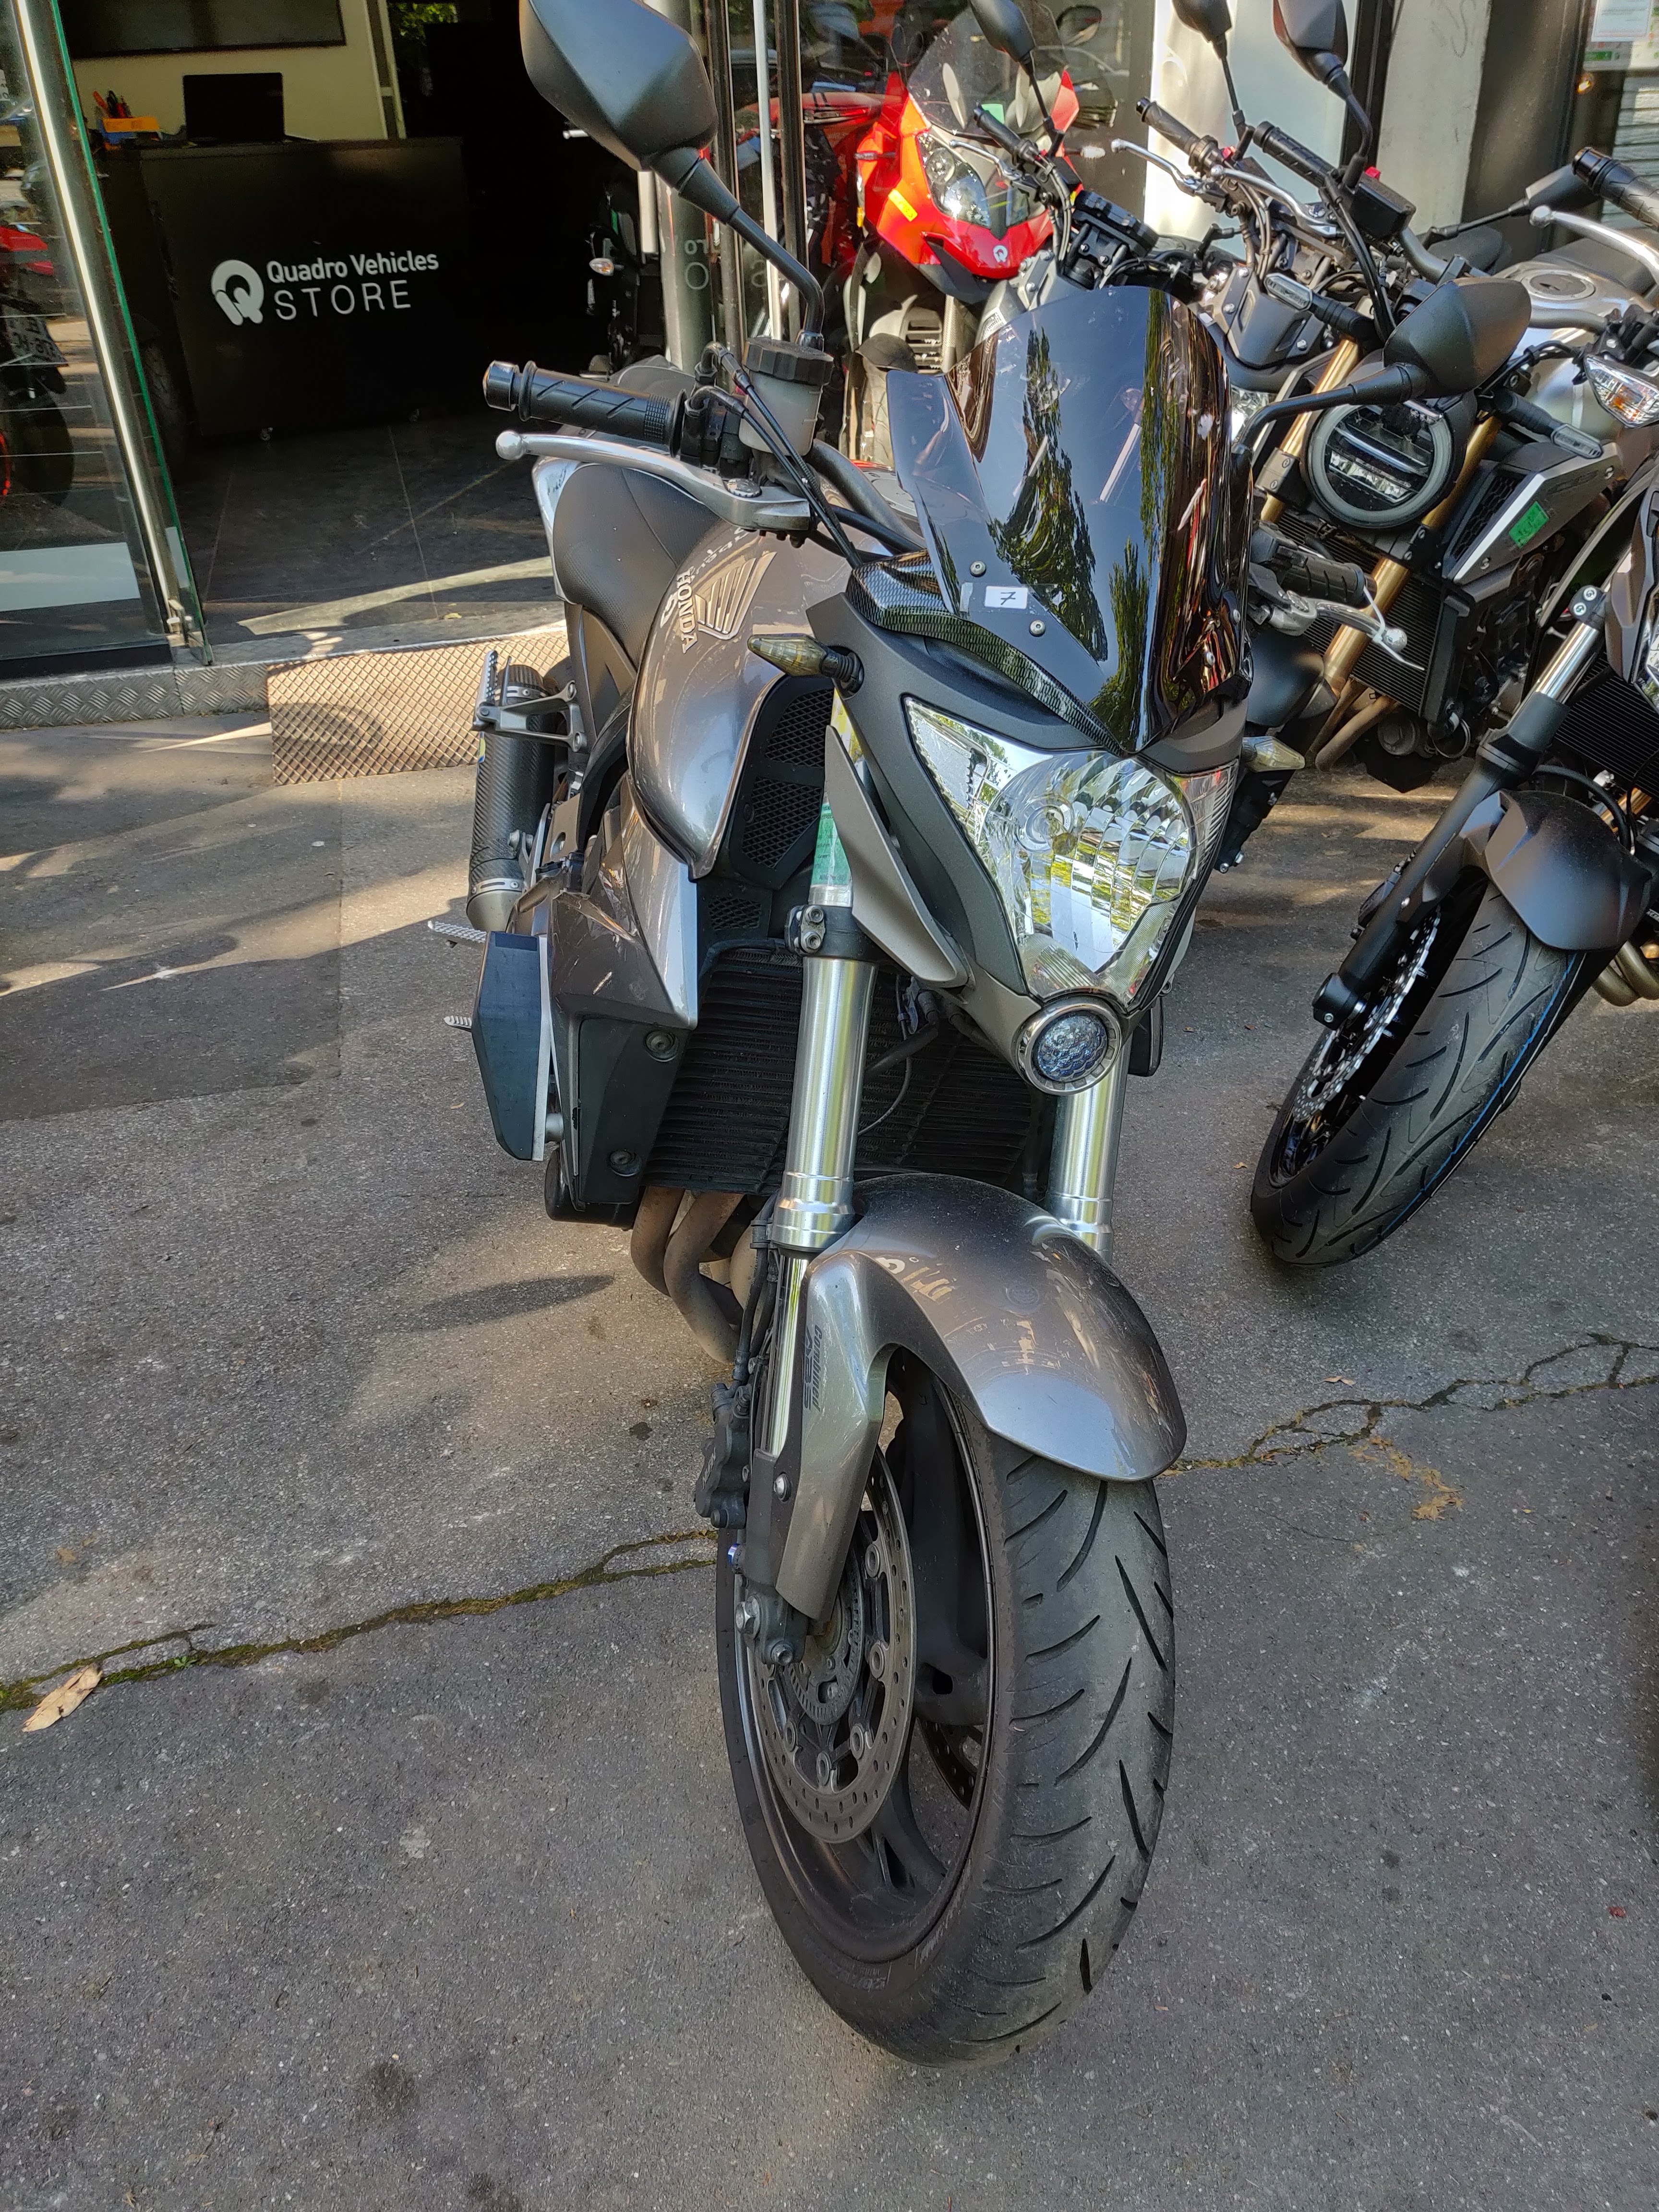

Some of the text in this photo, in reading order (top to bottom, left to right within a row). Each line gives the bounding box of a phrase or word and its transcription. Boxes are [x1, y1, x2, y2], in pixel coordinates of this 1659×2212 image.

[266, 250, 439, 283] Quadro Vehicles
[274, 280, 411, 320] STORE
[676, 570, 698, 654] HONDA
[1000, 591, 1016, 606] 7
[812, 1324, 822, 1412] Combined
